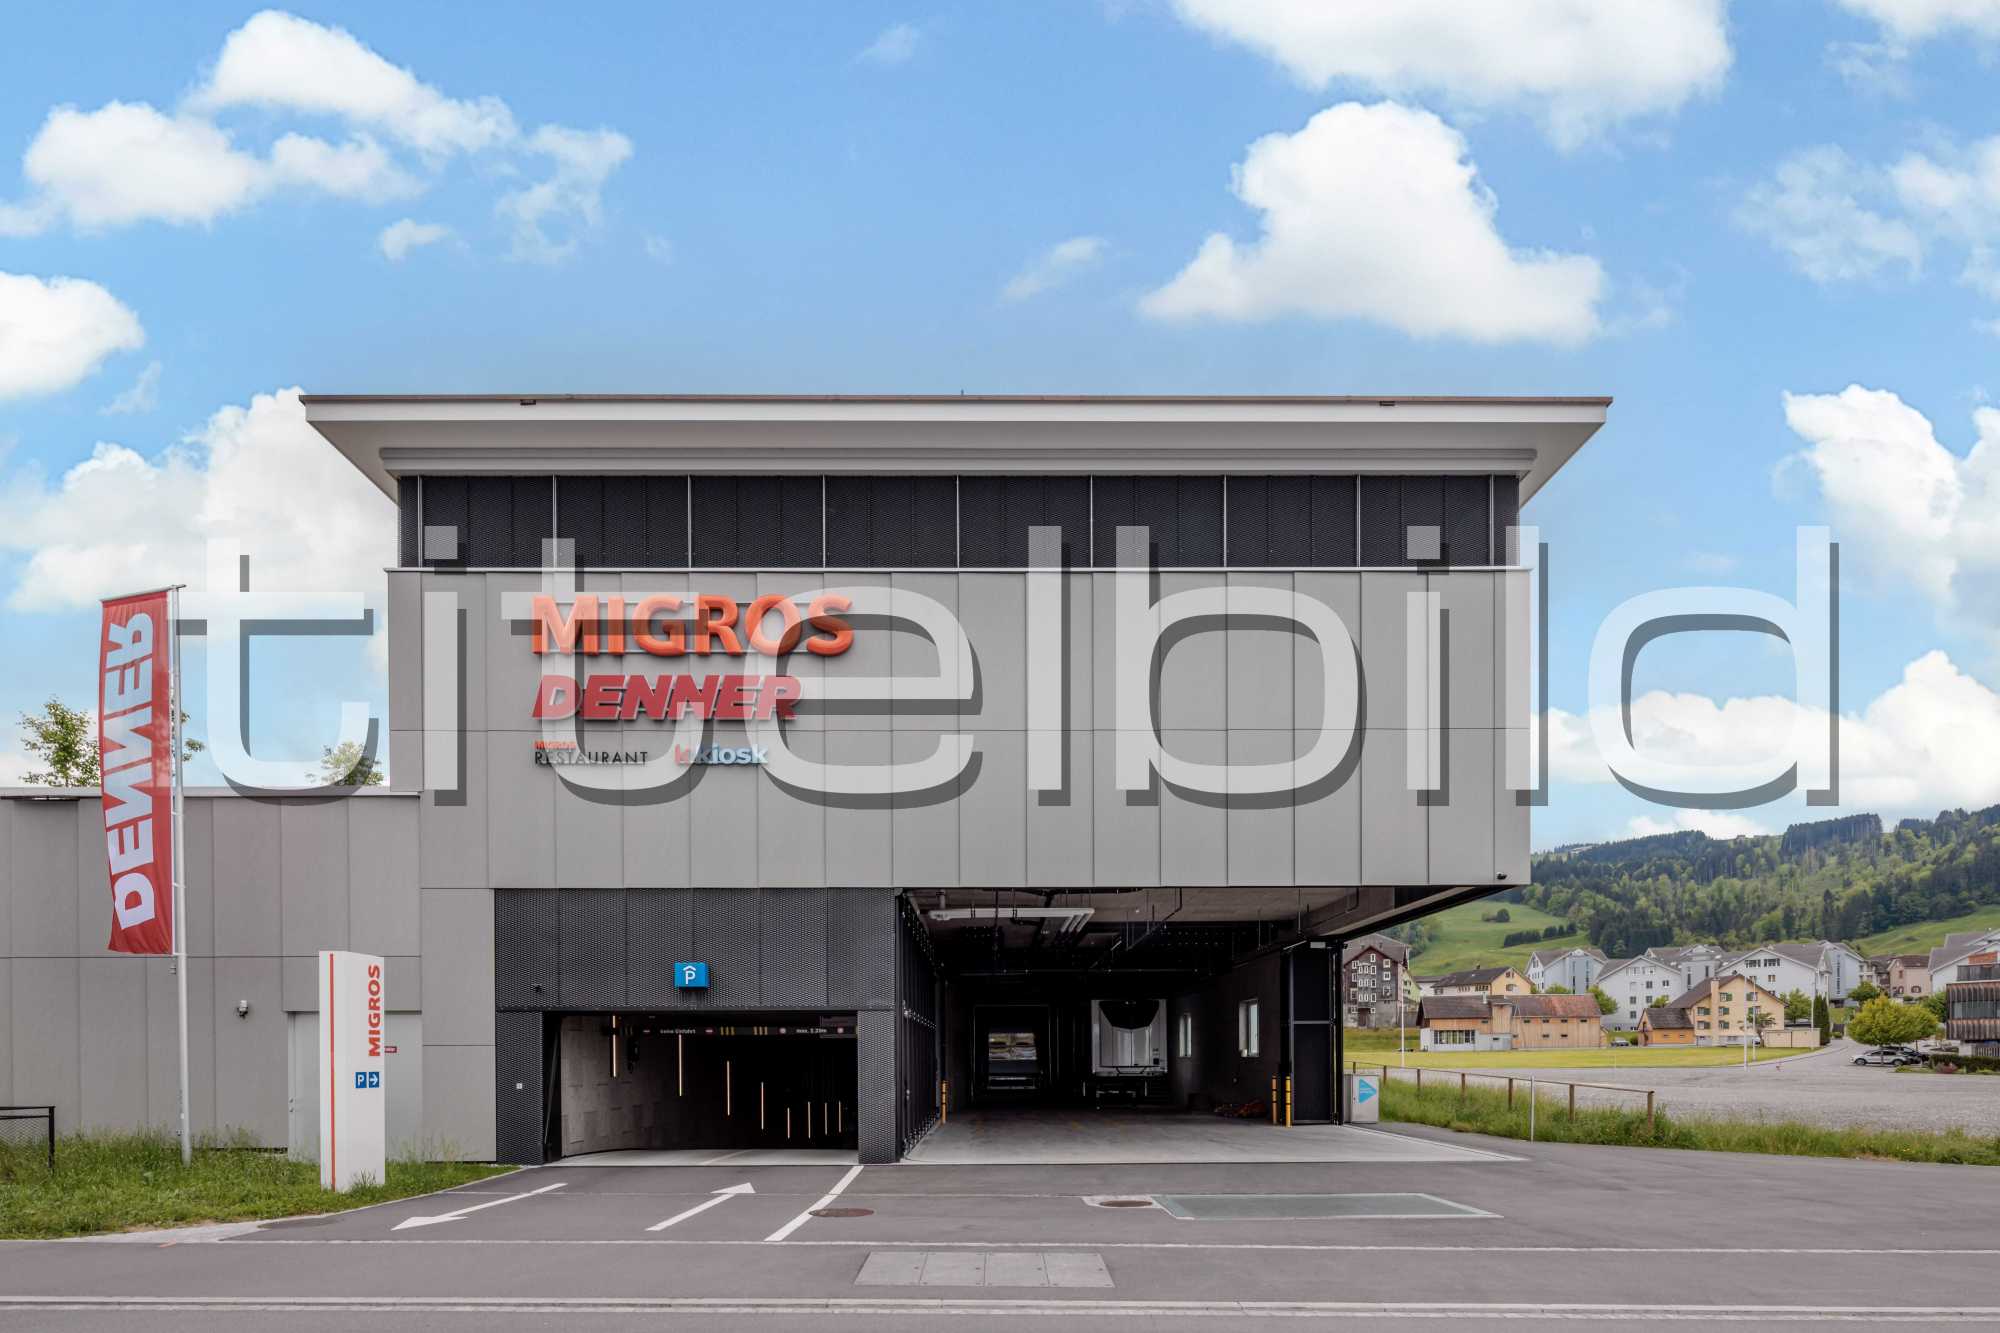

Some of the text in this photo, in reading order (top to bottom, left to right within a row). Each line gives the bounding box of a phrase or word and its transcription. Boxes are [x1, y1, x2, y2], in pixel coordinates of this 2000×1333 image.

[531, 594, 854, 656] MIGROS
[532, 673, 802, 720] DENNER
[535, 751, 648, 765] RESTAURANT
[696, 743, 769, 764] kiosk
[104, 613, 155, 929] DENNER
[685, 970, 696, 985] P
[368, 965, 381, 1057] MIGROS
[357, 1075, 365, 1086] P
